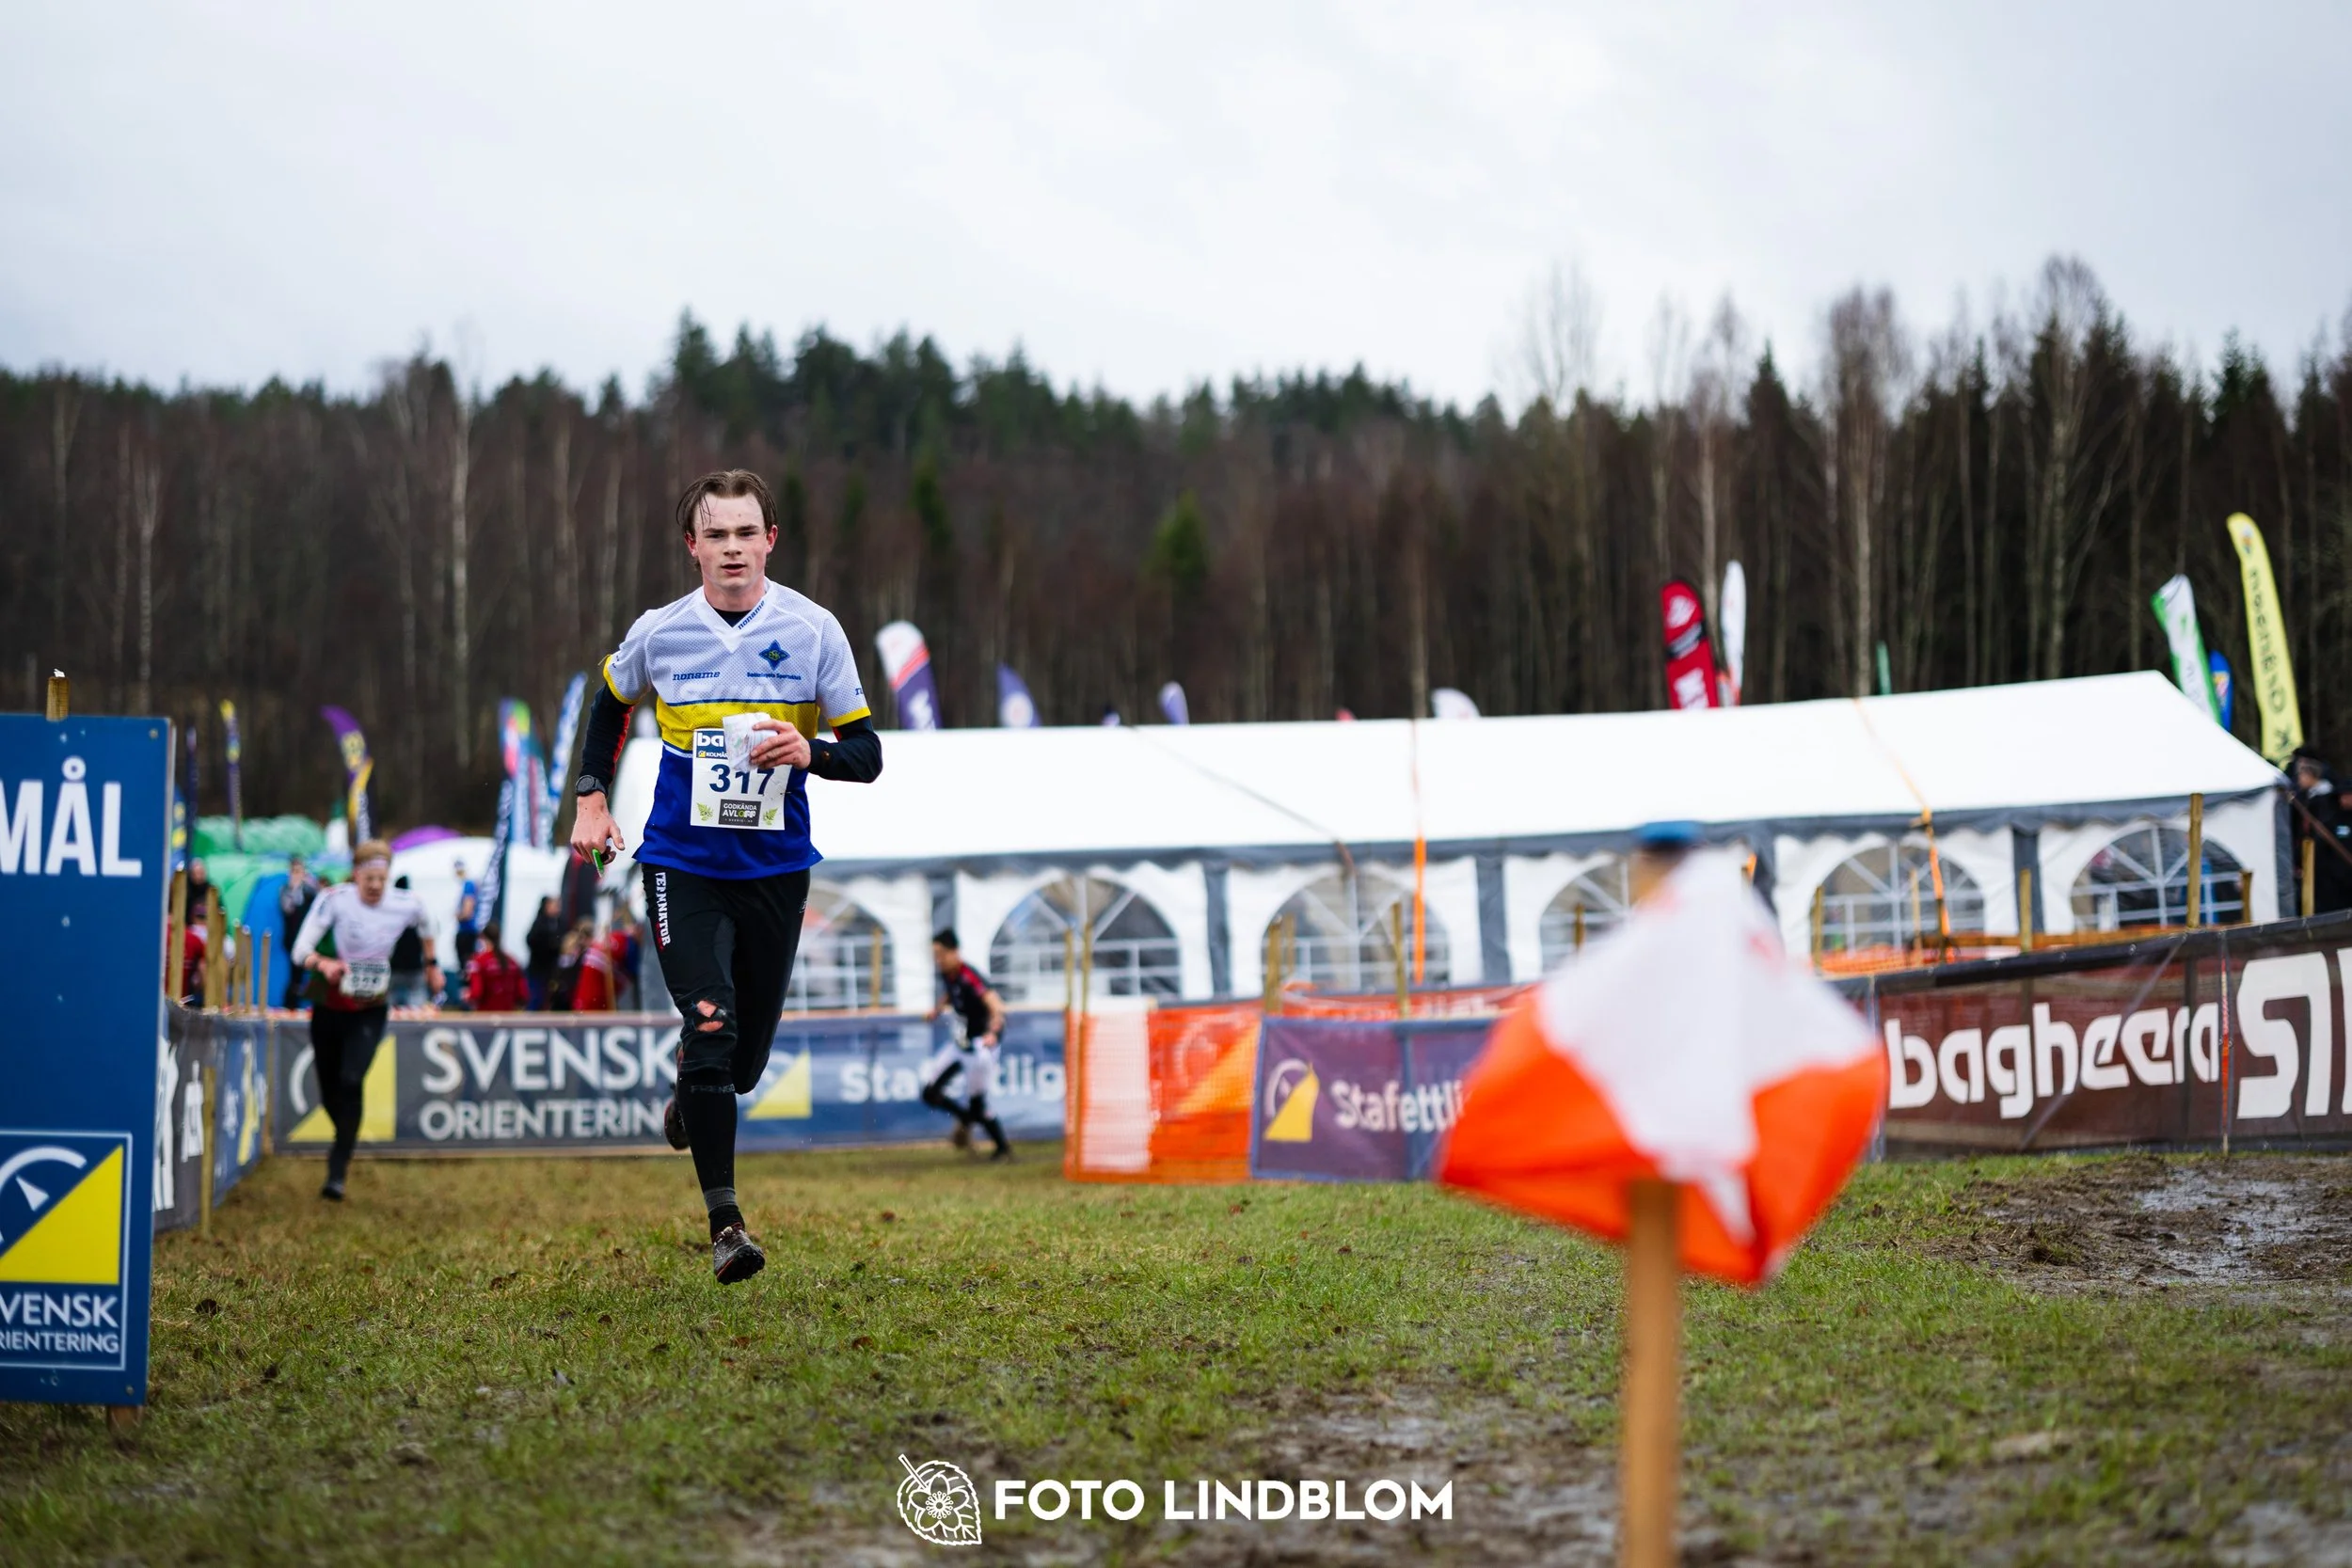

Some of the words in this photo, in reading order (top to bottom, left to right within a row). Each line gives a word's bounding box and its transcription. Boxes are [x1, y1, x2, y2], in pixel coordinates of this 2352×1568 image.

[738, 600, 765, 630] noname
[672, 671, 721, 681] noname
[708, 764, 775, 795] 317
[0, 755, 142, 879] MÅL
[423, 1026, 684, 1093] SVENSK
[1883, 1002, 2219, 1120] bagheera
[0, 1291, 119, 1328] VENSK
